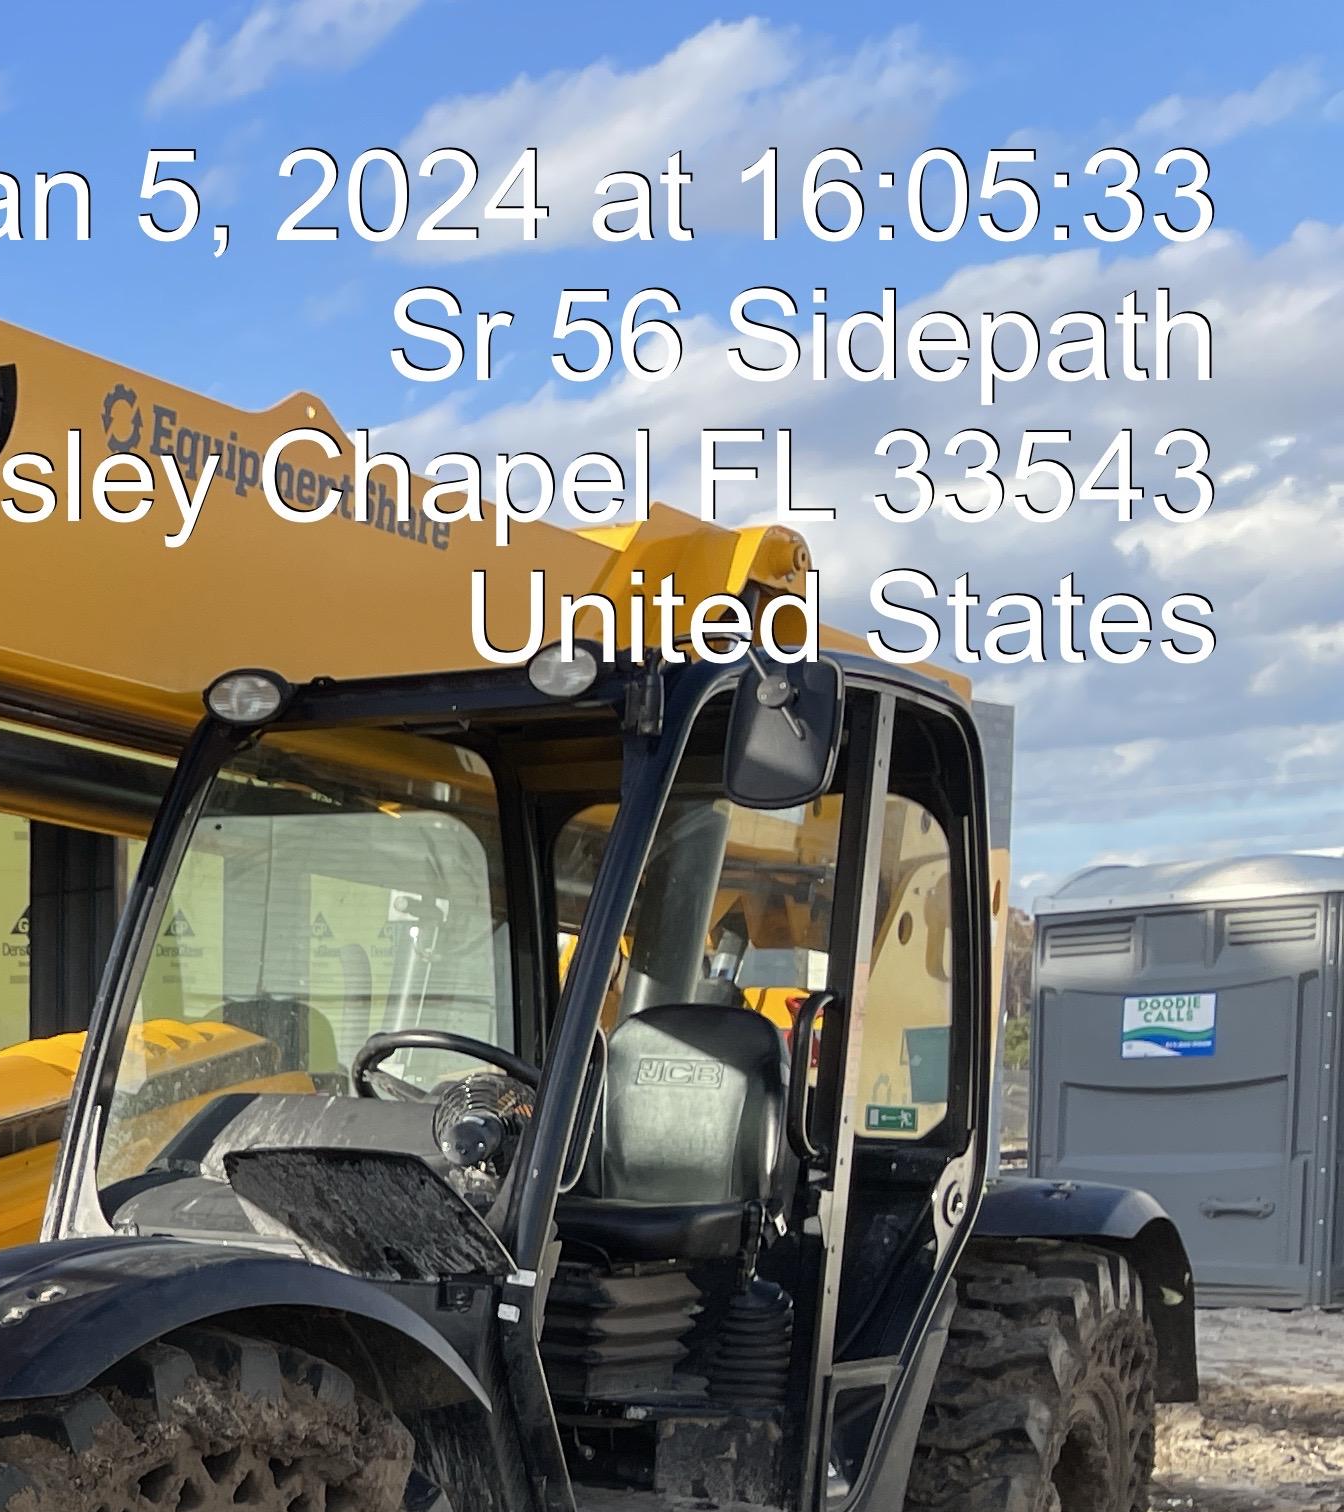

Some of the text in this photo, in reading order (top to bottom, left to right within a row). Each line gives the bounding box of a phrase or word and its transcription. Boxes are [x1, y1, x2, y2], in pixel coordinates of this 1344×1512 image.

[1138, 996, 1200, 1011] DOODIE
[1144, 1010, 1193, 1024] CALLS
[638, 1060, 721, 1086] JCB
